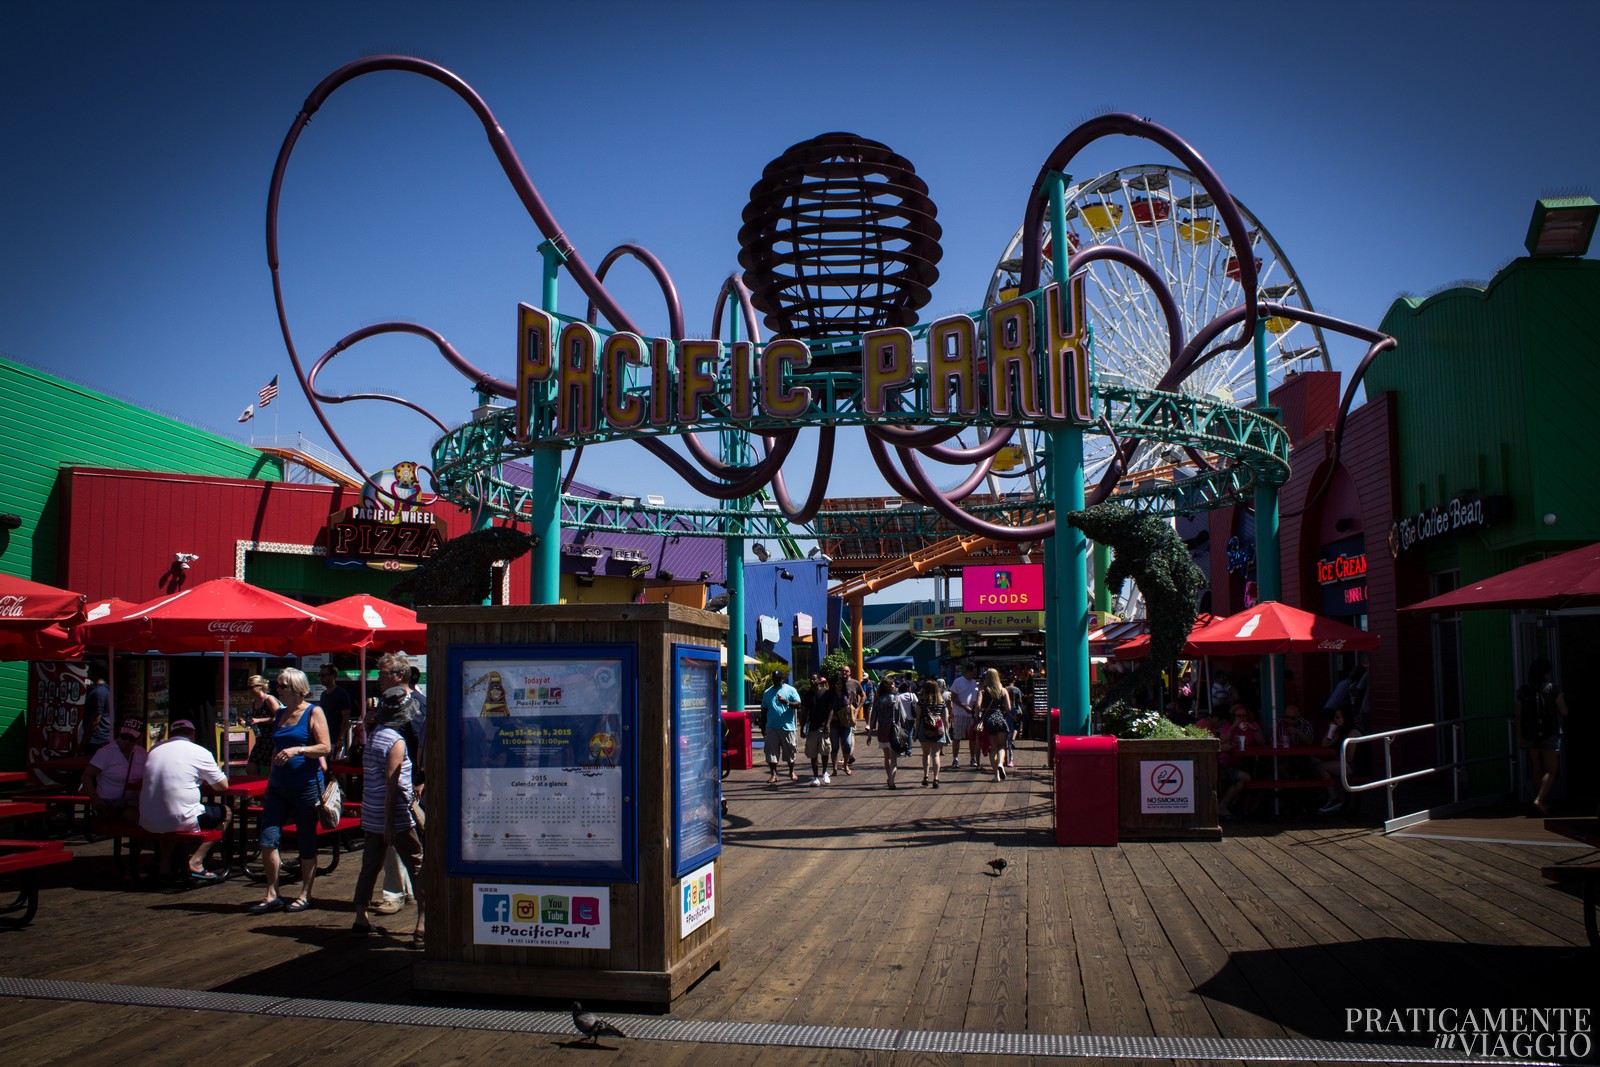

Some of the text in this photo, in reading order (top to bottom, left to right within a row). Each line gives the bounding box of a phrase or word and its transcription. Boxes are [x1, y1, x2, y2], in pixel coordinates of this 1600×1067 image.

[516, 269, 1093, 444] PACIFIC PARK
[352, 506, 436, 525] PACIFIC WHEEL
[1399, 498, 1484, 551] The Coffee Bean
[335, 523, 445, 559] PIZZA
[566, 545, 602, 557] TACO
[615, 549, 645, 560] BELL
[1316, 561, 1334, 583] ICE
[979, 593, 1028, 605] FOODS
[1344, 585, 1365, 605] FUNNEL
[964, 615, 1033, 626] Pacific Park
[524, 676, 542, 685] Today
[499, 729, 514, 737] Aug
[552, 728, 573, 736] 2015
[548, 899, 562, 908] You
[547, 910, 564, 921] Tube
[491, 924, 590, 939] #PacificPark
